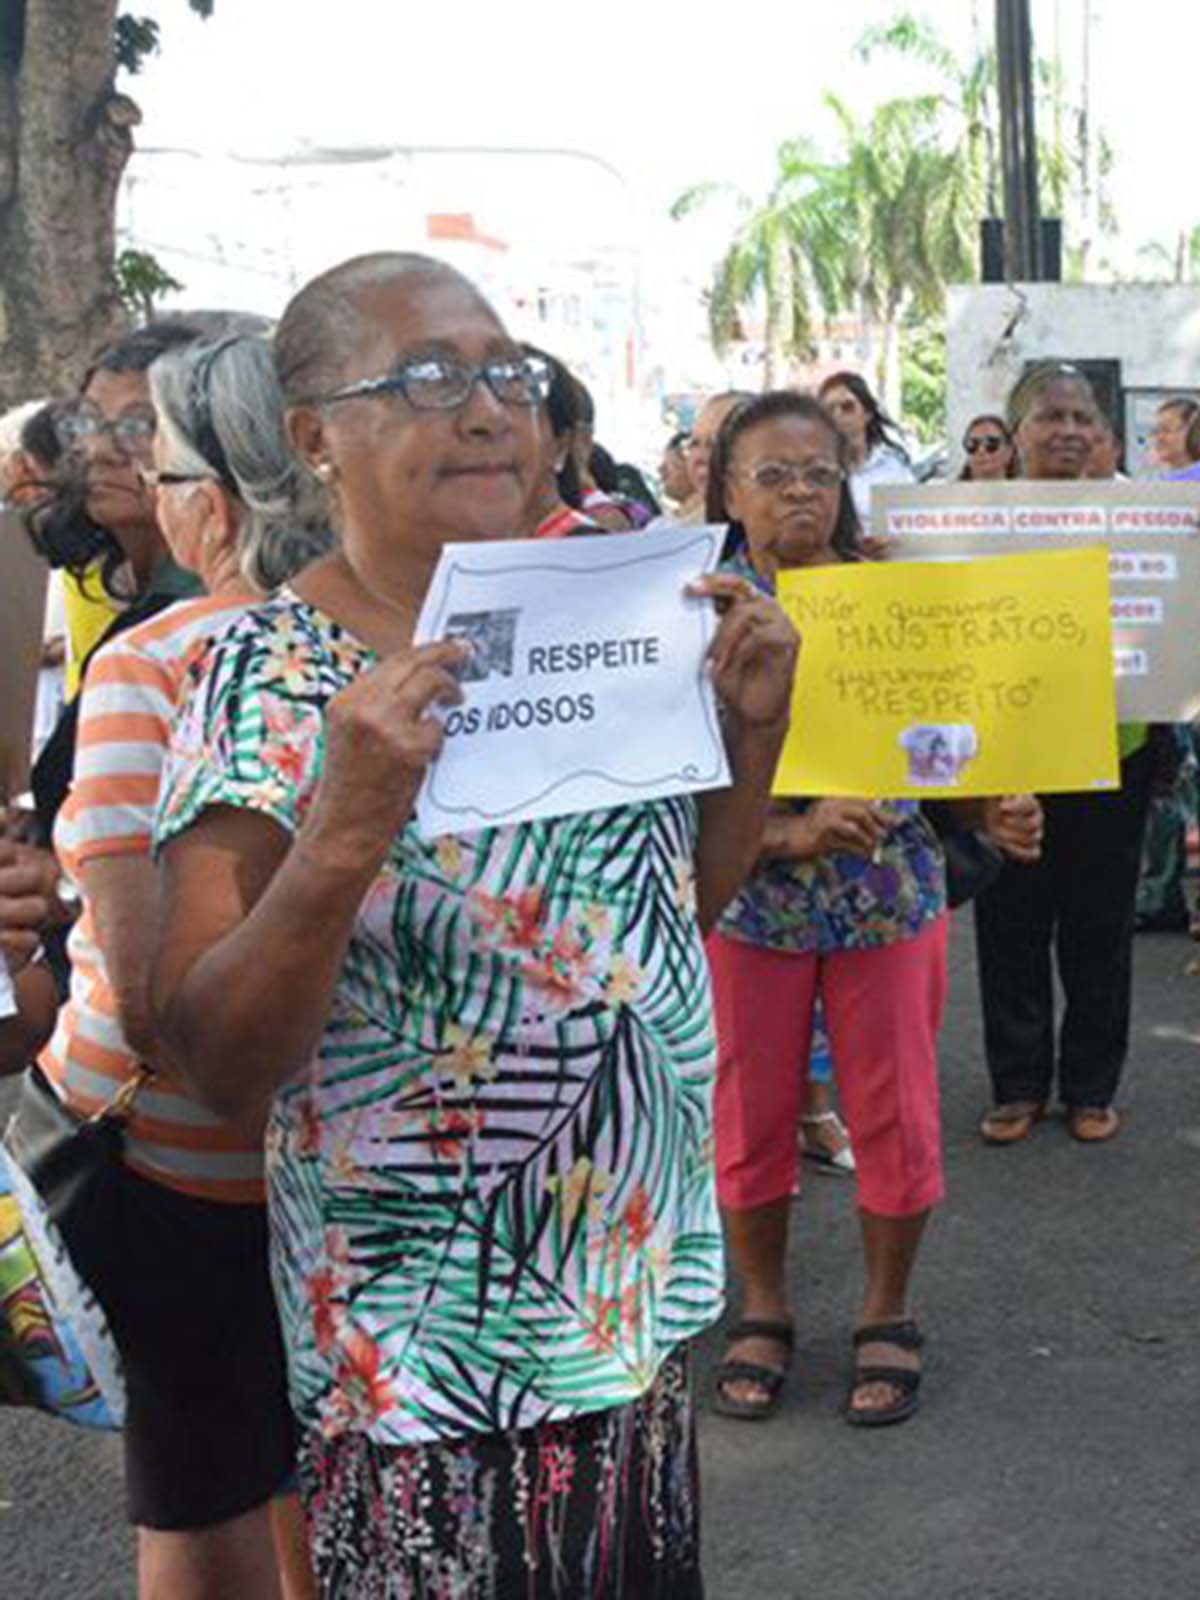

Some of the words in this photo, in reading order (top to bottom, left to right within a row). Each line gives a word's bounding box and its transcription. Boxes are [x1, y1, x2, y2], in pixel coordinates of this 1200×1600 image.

[1016, 510, 1102, 527] CONTRA
[528, 637, 659, 674] RESPEITE
[444, 706, 482, 738] OS
[487, 693, 595, 732] IDOSOS
